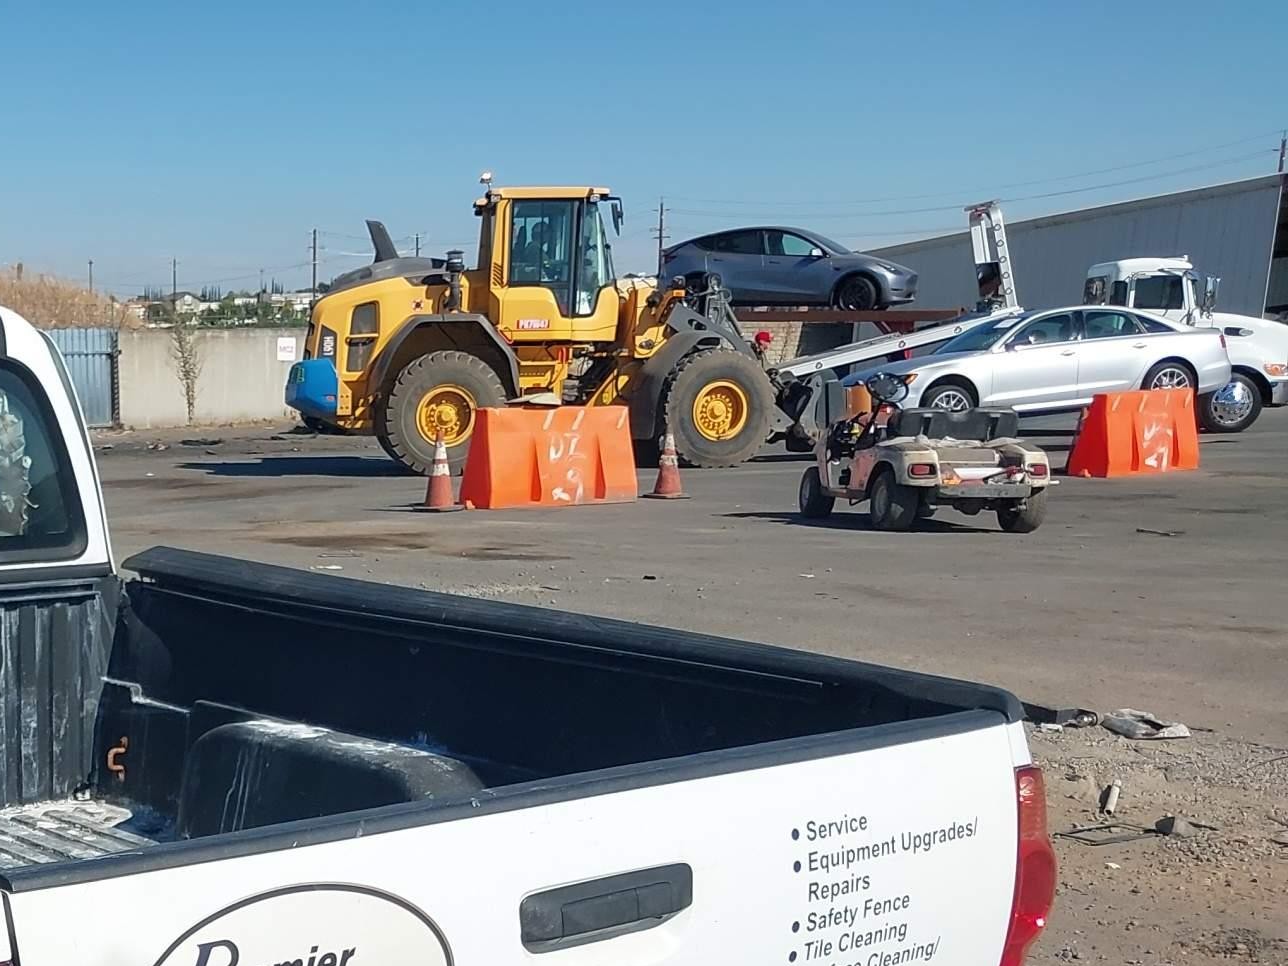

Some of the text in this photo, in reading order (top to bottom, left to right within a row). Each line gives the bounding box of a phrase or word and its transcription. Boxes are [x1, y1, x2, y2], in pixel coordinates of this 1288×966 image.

[806, 813, 868, 842] Service
[808, 815, 978, 874] Equipment Upgrades/
[808, 873, 871, 903] Repairs
[806, 894, 910, 933] Safety Fence
[804, 922, 908, 961] Tile Cleaning
